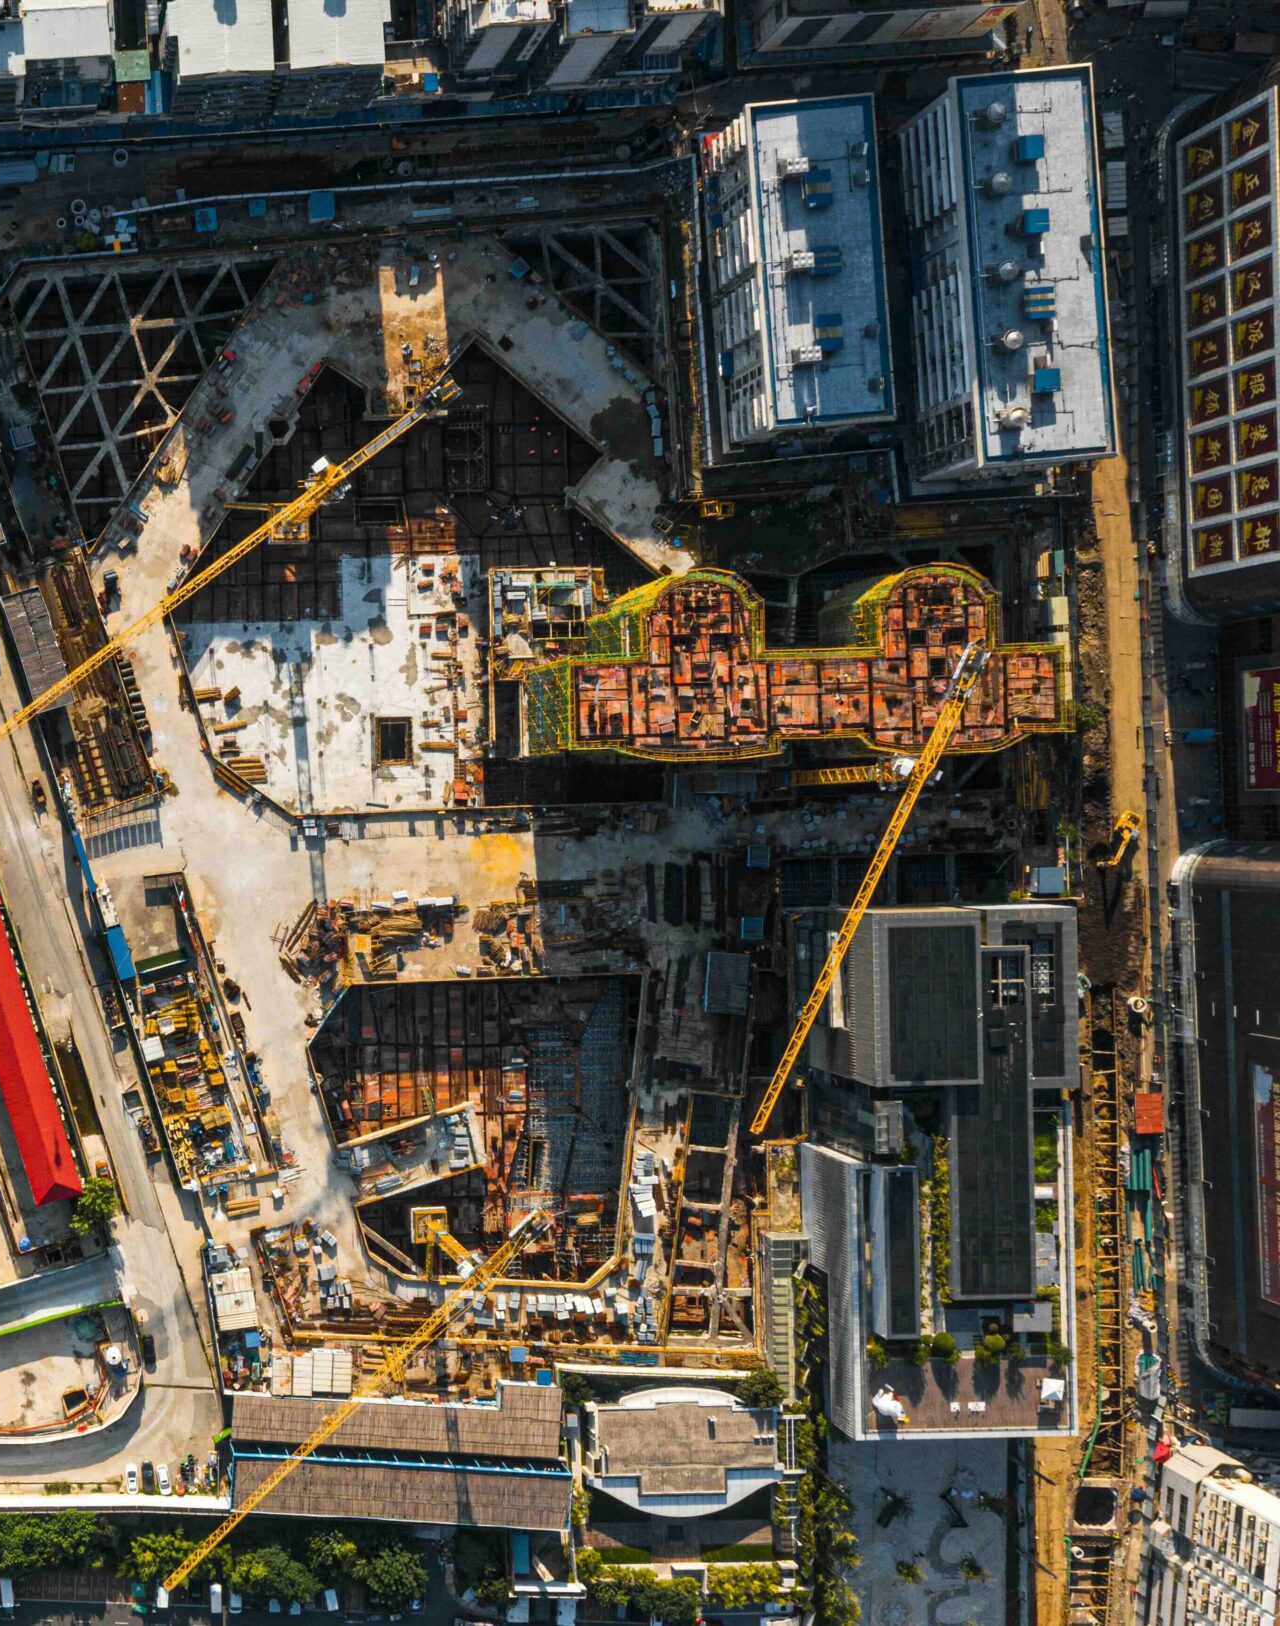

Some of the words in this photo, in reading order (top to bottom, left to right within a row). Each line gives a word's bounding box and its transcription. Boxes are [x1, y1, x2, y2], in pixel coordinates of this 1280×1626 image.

[1197, 146, 1224, 558] 原创精品引领新国潮
[1243, 118, 1271, 550] 金正茂汉派服装总部
